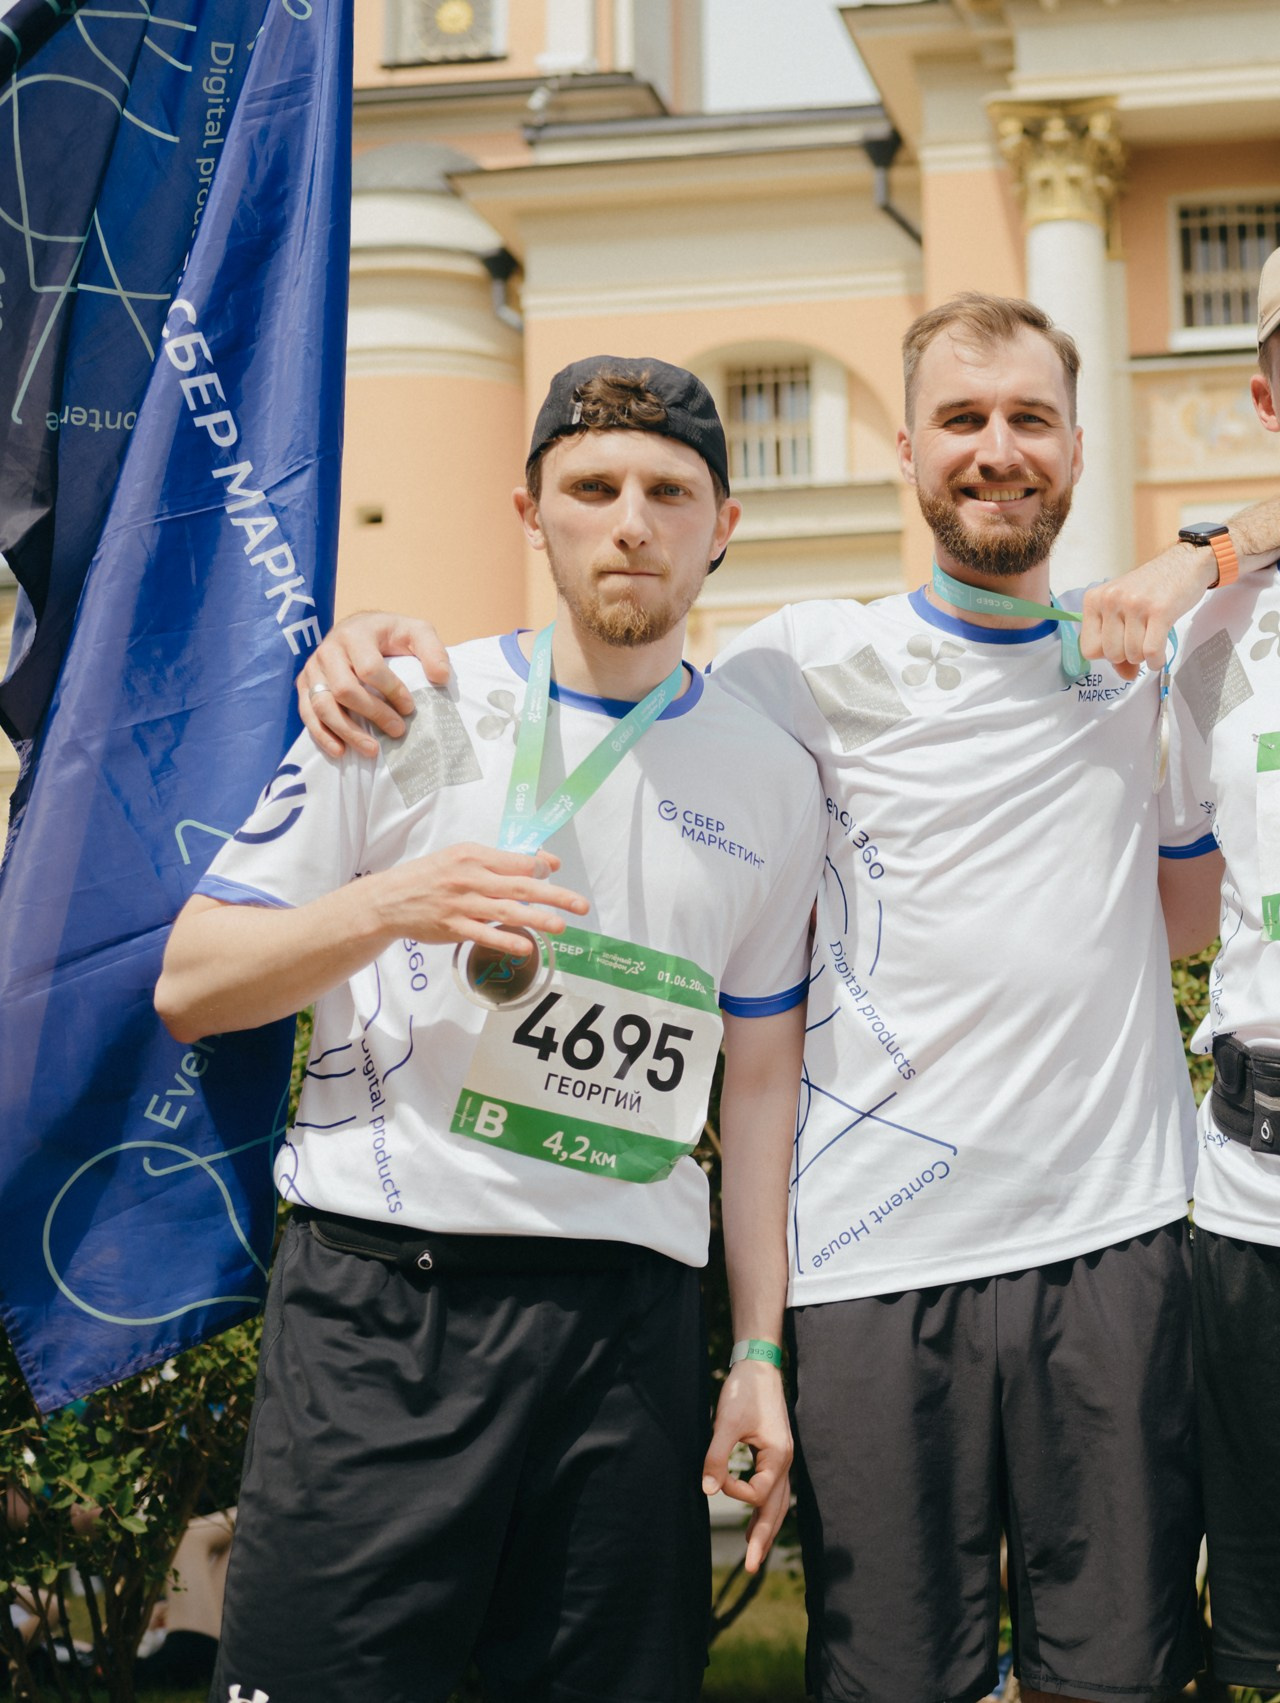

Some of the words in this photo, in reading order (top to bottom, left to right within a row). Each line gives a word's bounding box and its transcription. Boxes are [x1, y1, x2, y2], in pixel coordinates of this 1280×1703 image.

[203, 41, 235, 148] Digital
[162, 298, 239, 448] СБЕР
[683, 810, 725, 833] СБЕР
[853, 830, 885, 880] 360
[550, 941, 585, 957] СБЕР
[512, 992, 694, 1092] 4695
[829, 940, 869, 1003] Digital
[857, 1001, 917, 1082] products
[544, 1072, 642, 1113] ГЕОРГИЙ
[369, 1115, 403, 1214] products
[868, 1160, 951, 1224] Content
[811, 1220, 871, 1269] House
